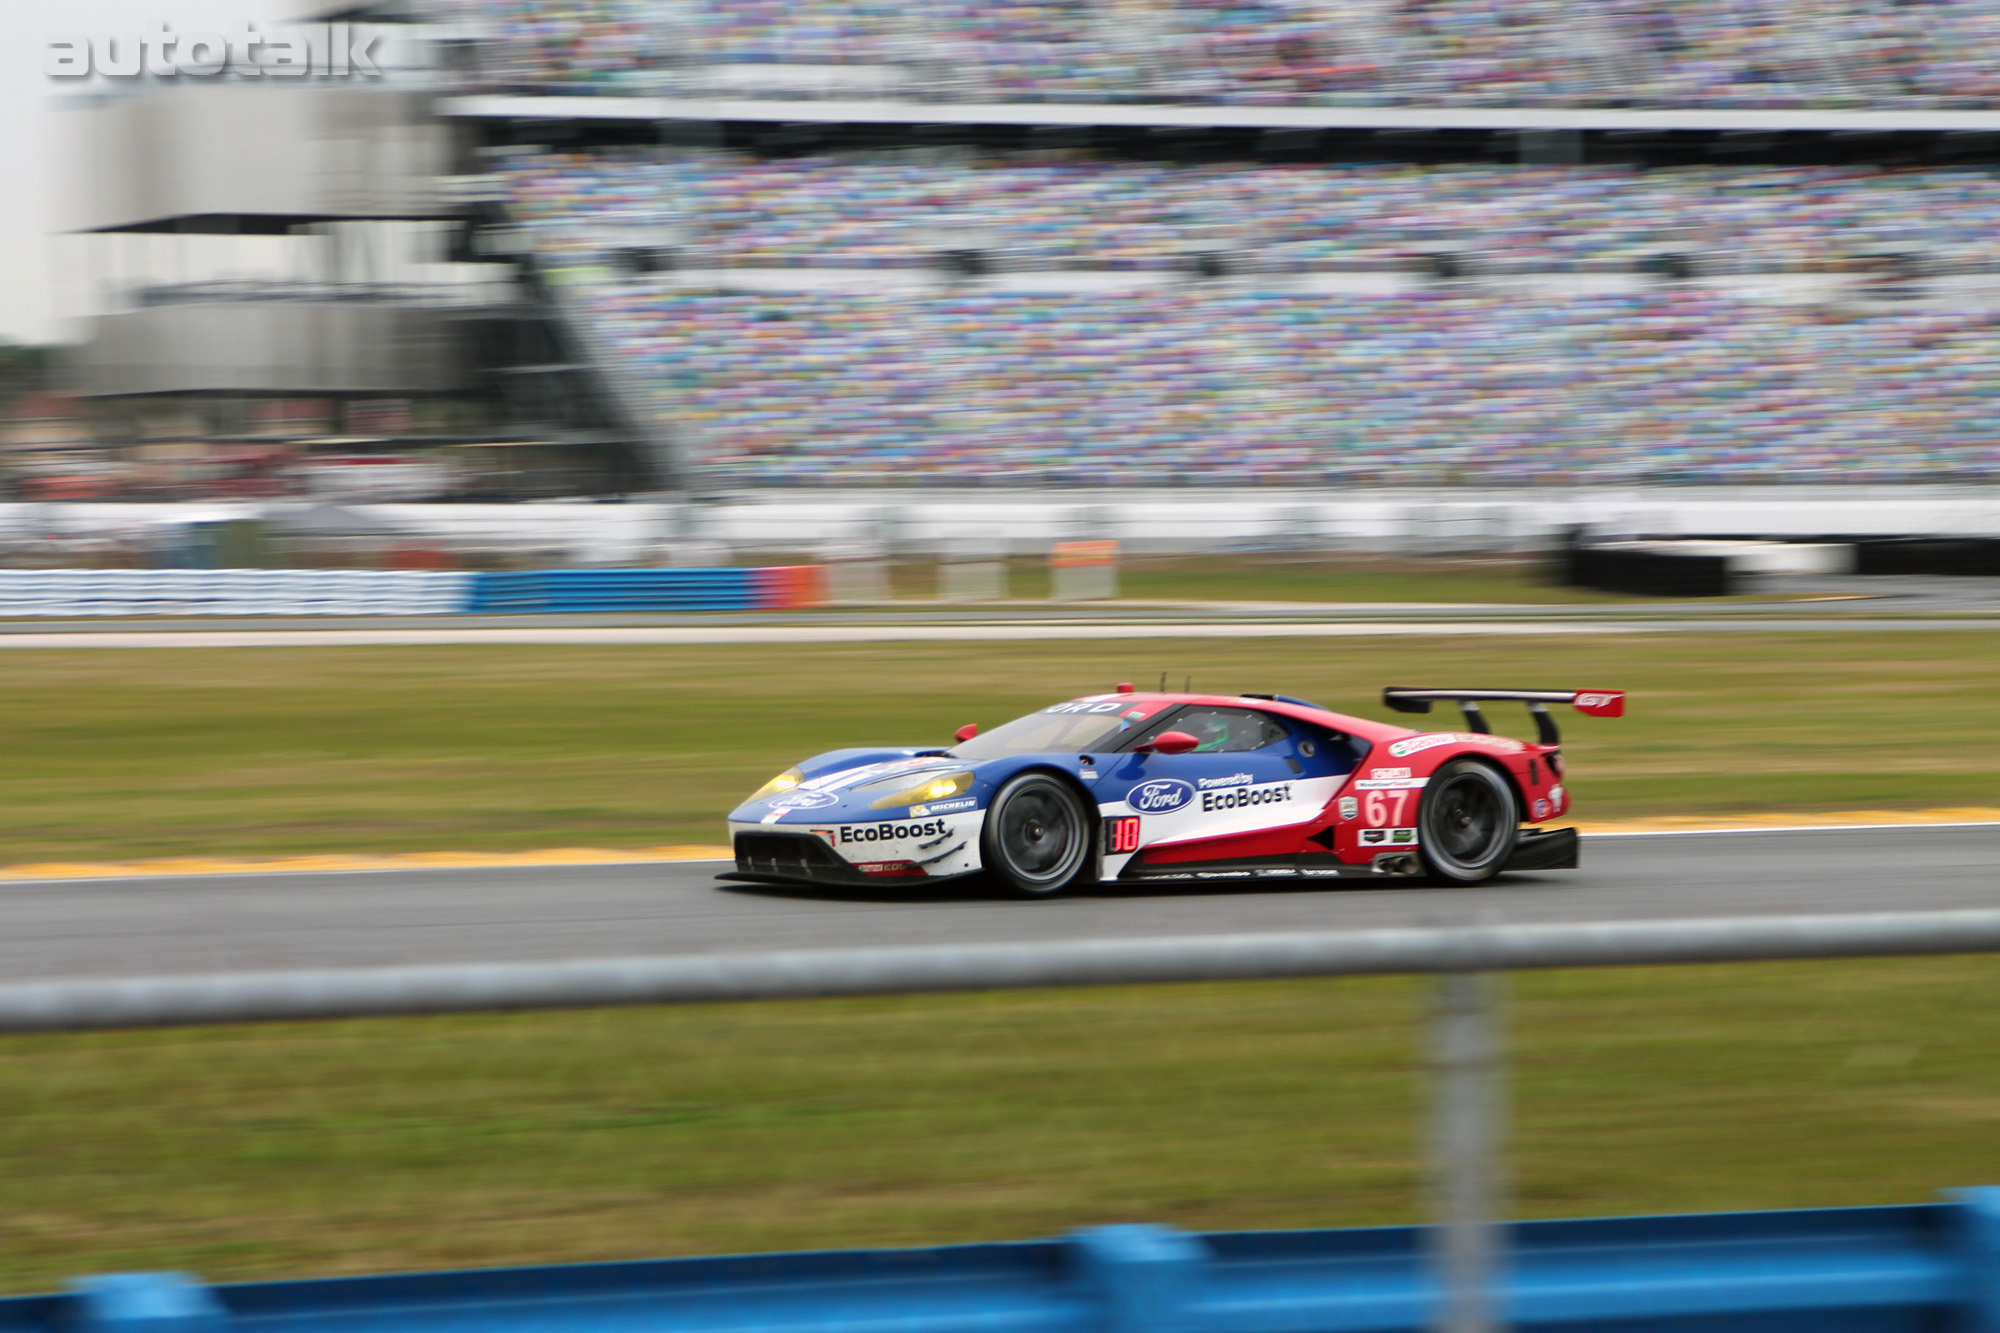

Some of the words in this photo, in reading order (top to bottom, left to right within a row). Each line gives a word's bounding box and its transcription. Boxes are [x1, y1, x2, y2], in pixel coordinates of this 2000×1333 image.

[1044, 702, 1122, 714] ORD
[1574, 692, 1626, 708] GT
[1198, 773, 1241, 789] Powered
[1241, 772, 1254, 785] by
[930, 799, 976, 812] MICHELIN
[1139, 783, 1183, 810] Ford
[1202, 783, 1292, 812] EcoBoost
[1365, 790, 1408, 828] 67
[840, 818, 946, 843] EcoBoost
[1114, 817, 1140, 851] 10
